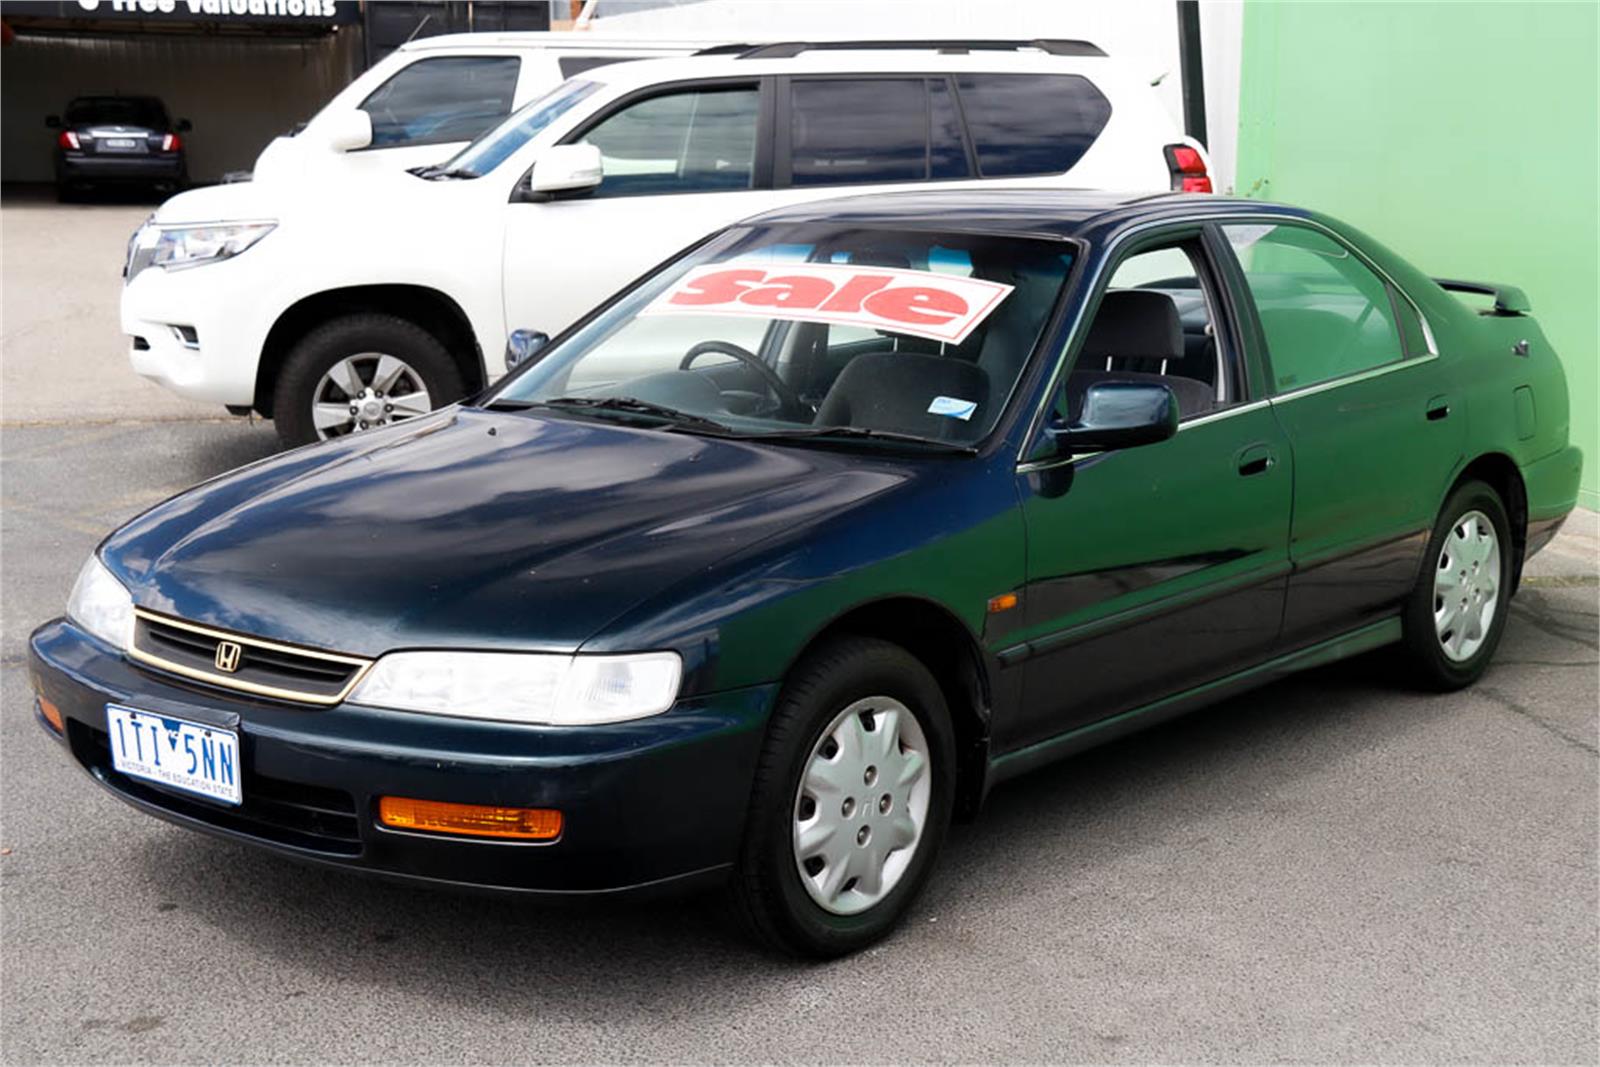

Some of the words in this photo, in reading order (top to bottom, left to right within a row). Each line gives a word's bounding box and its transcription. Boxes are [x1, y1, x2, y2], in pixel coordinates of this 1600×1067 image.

[668, 269, 969, 326] sale
[121, 760, 152, 774] VICTORIA
[158, 768, 171, 780] THE
[172, 773, 212, 791] EDUCATION
[213, 784, 233, 798] STATE
[183, 733, 234, 786] 5NN
